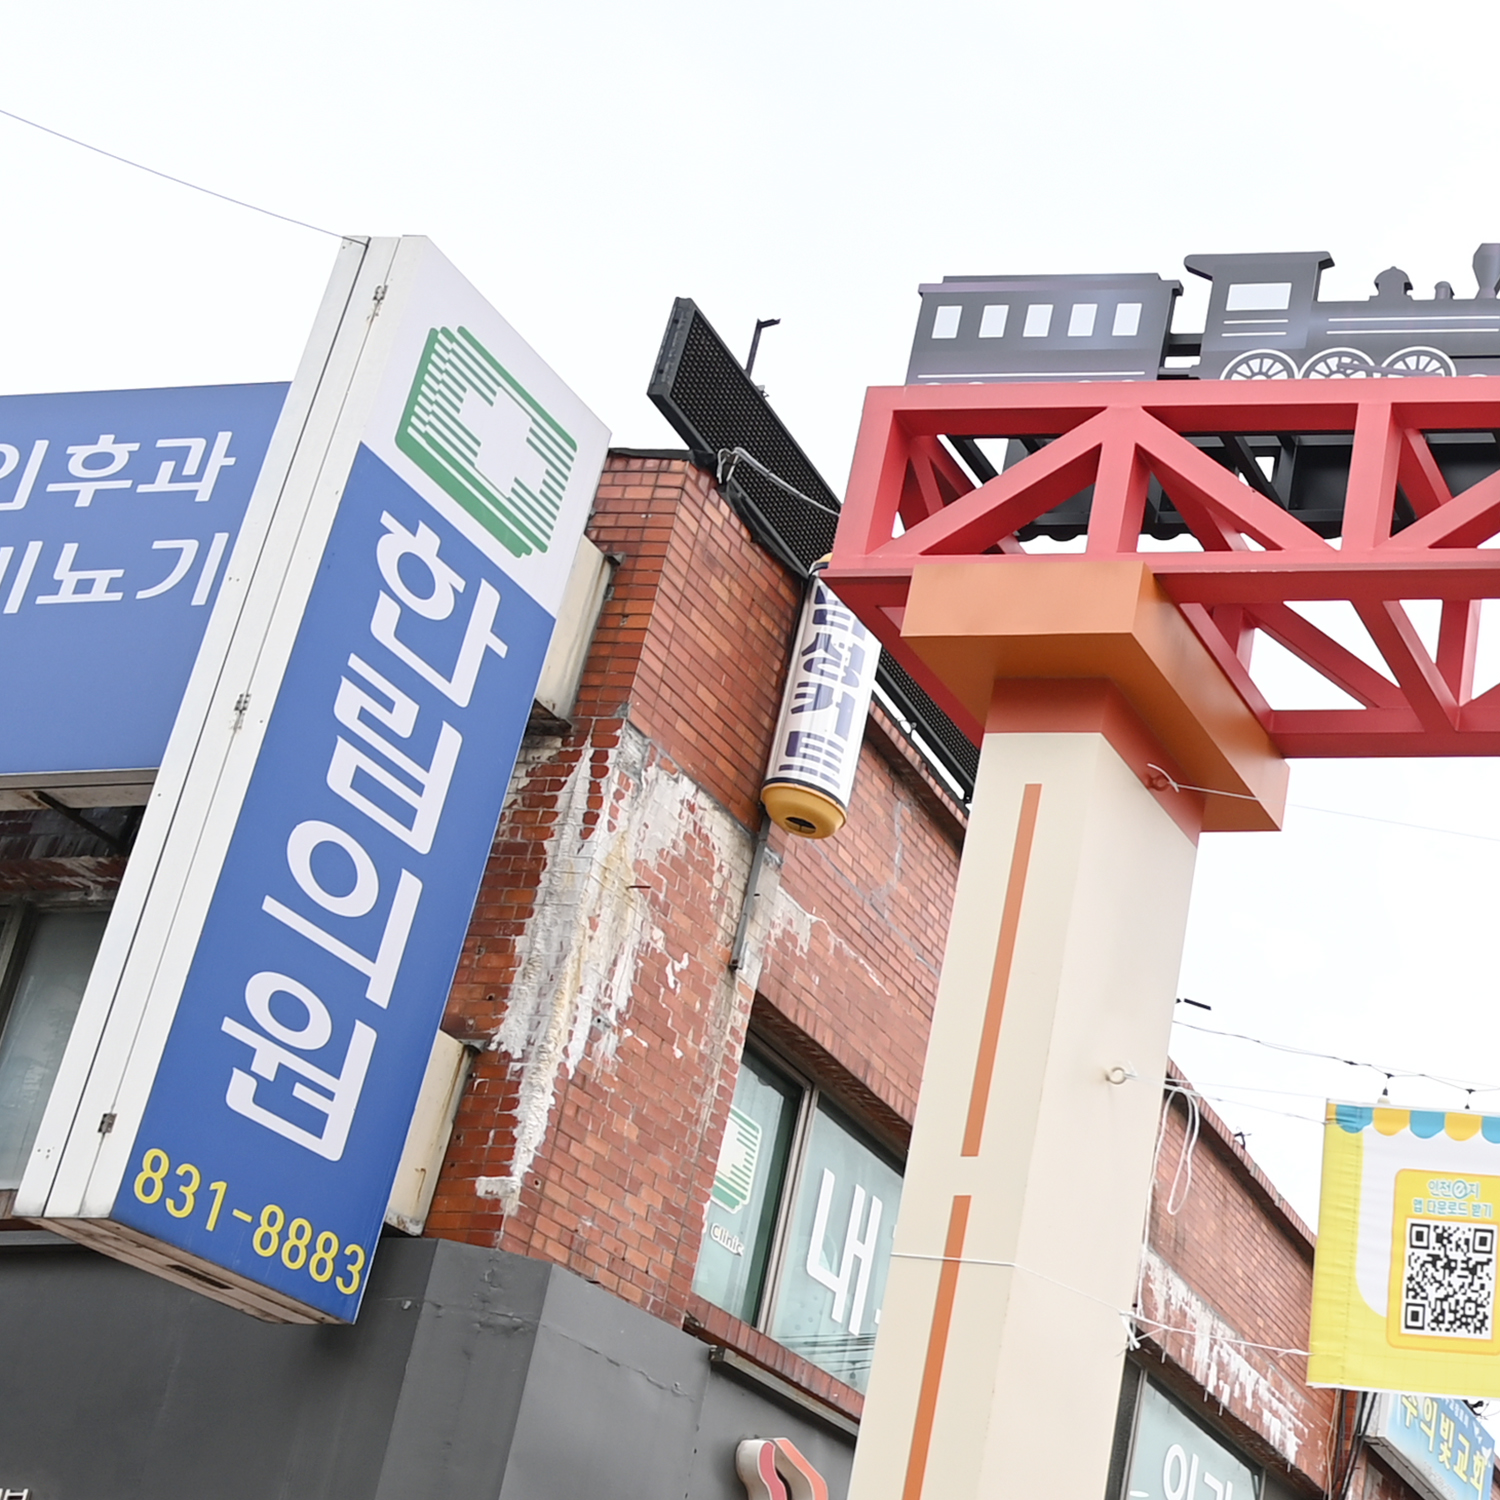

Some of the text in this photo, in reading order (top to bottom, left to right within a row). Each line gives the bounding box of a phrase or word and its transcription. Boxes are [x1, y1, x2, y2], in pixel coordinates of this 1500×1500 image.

[221, 509, 508, 1161] 한림의원
[134, 1148, 364, 1296] 831-8883
[710, 1224, 742, 1256] Clinic
[806, 1168, 883, 1336] 내
